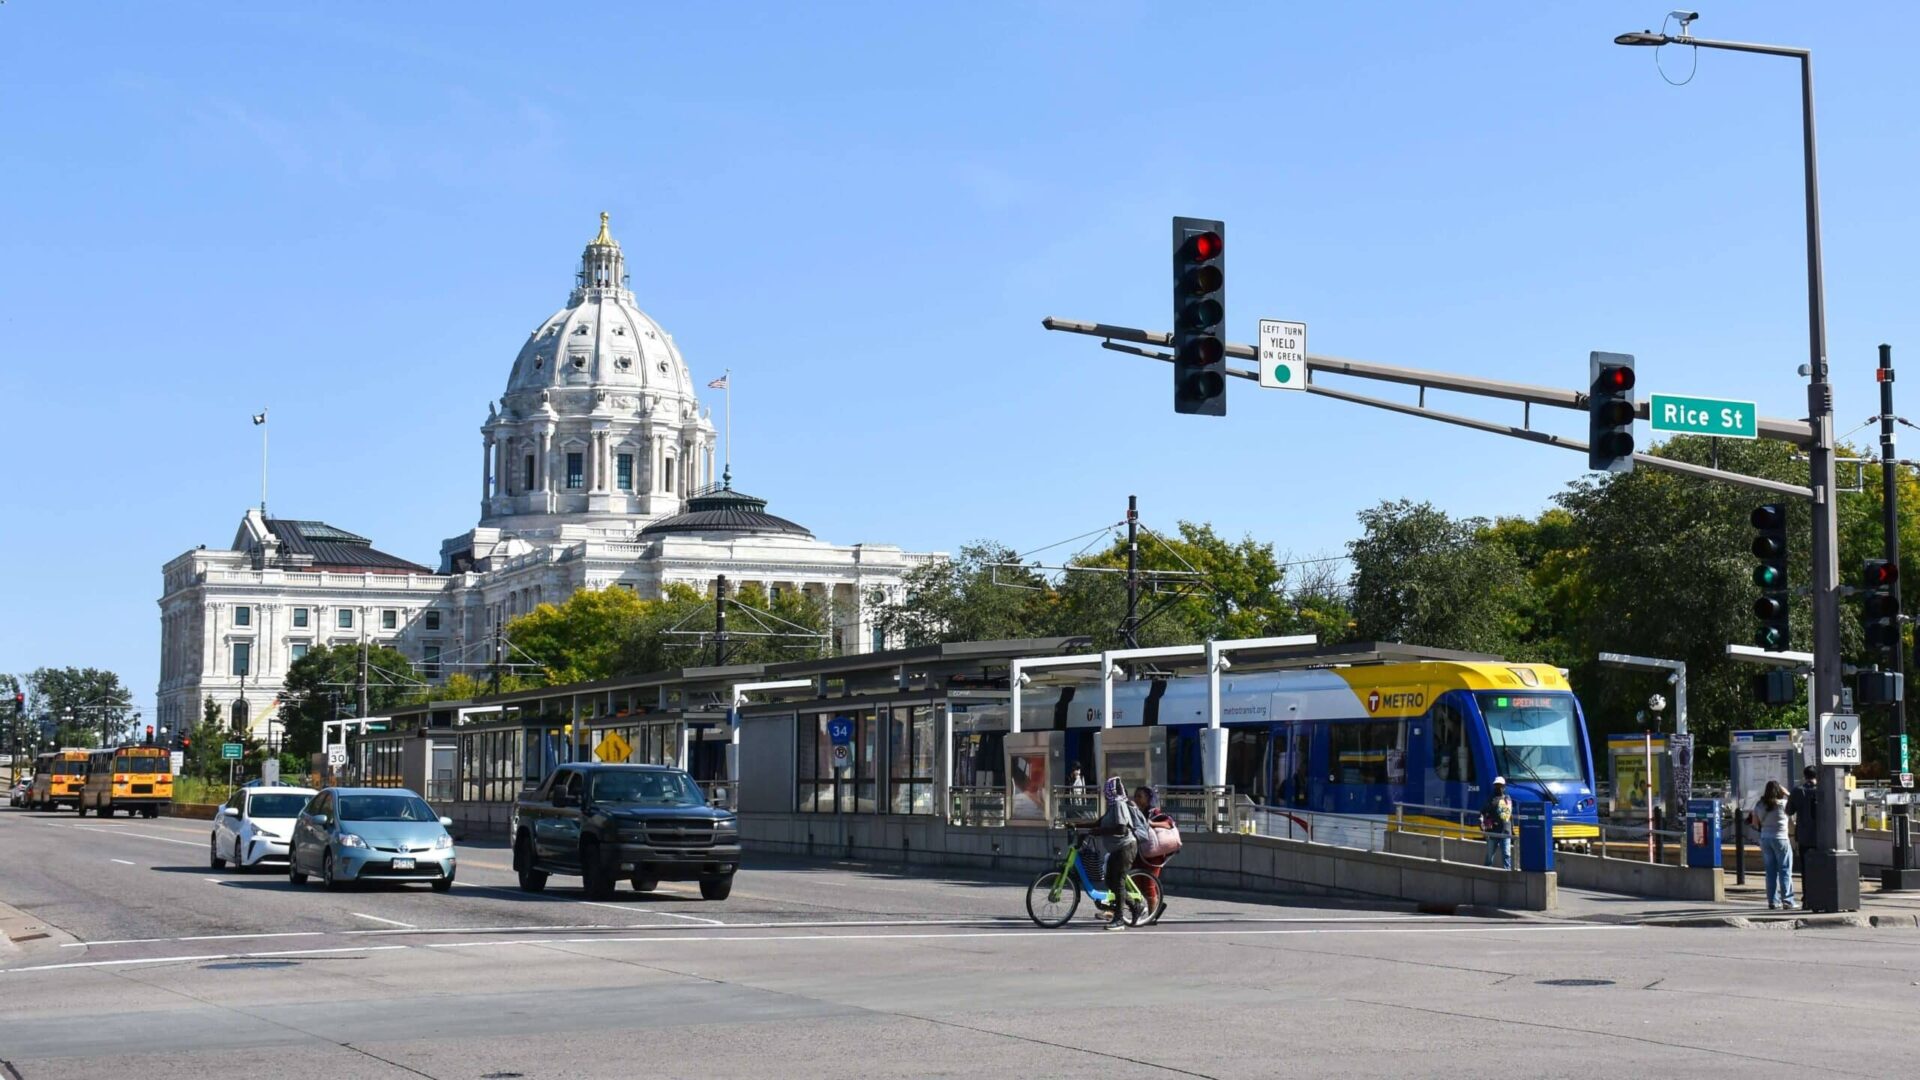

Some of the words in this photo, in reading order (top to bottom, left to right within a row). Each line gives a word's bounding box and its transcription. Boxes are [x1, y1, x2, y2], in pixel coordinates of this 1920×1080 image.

[1263, 325, 1279, 334] LEFT
[1284, 327, 1303, 336] TURN
[1270, 337, 1295, 349] YIELD
[1263, 350, 1274, 359] ON
[1278, 352, 1302, 361] GREEN
[1664, 403, 1709, 426] Rice
[1720, 408, 1742, 429] St
[1383, 693, 1424, 708] METRO
[1512, 698, 1533, 707] GREEN
[1535, 698, 1553, 707] LINE
[1223, 706, 1267, 716] metrotransit.org
[1833, 721, 1847, 730] NO
[832, 726, 847, 737] 34
[1829, 734, 1852, 744] TURN
[1824, 748, 1837, 757] ON
[1840, 749, 1857, 758] RED
[331, 755, 344, 763] 30
